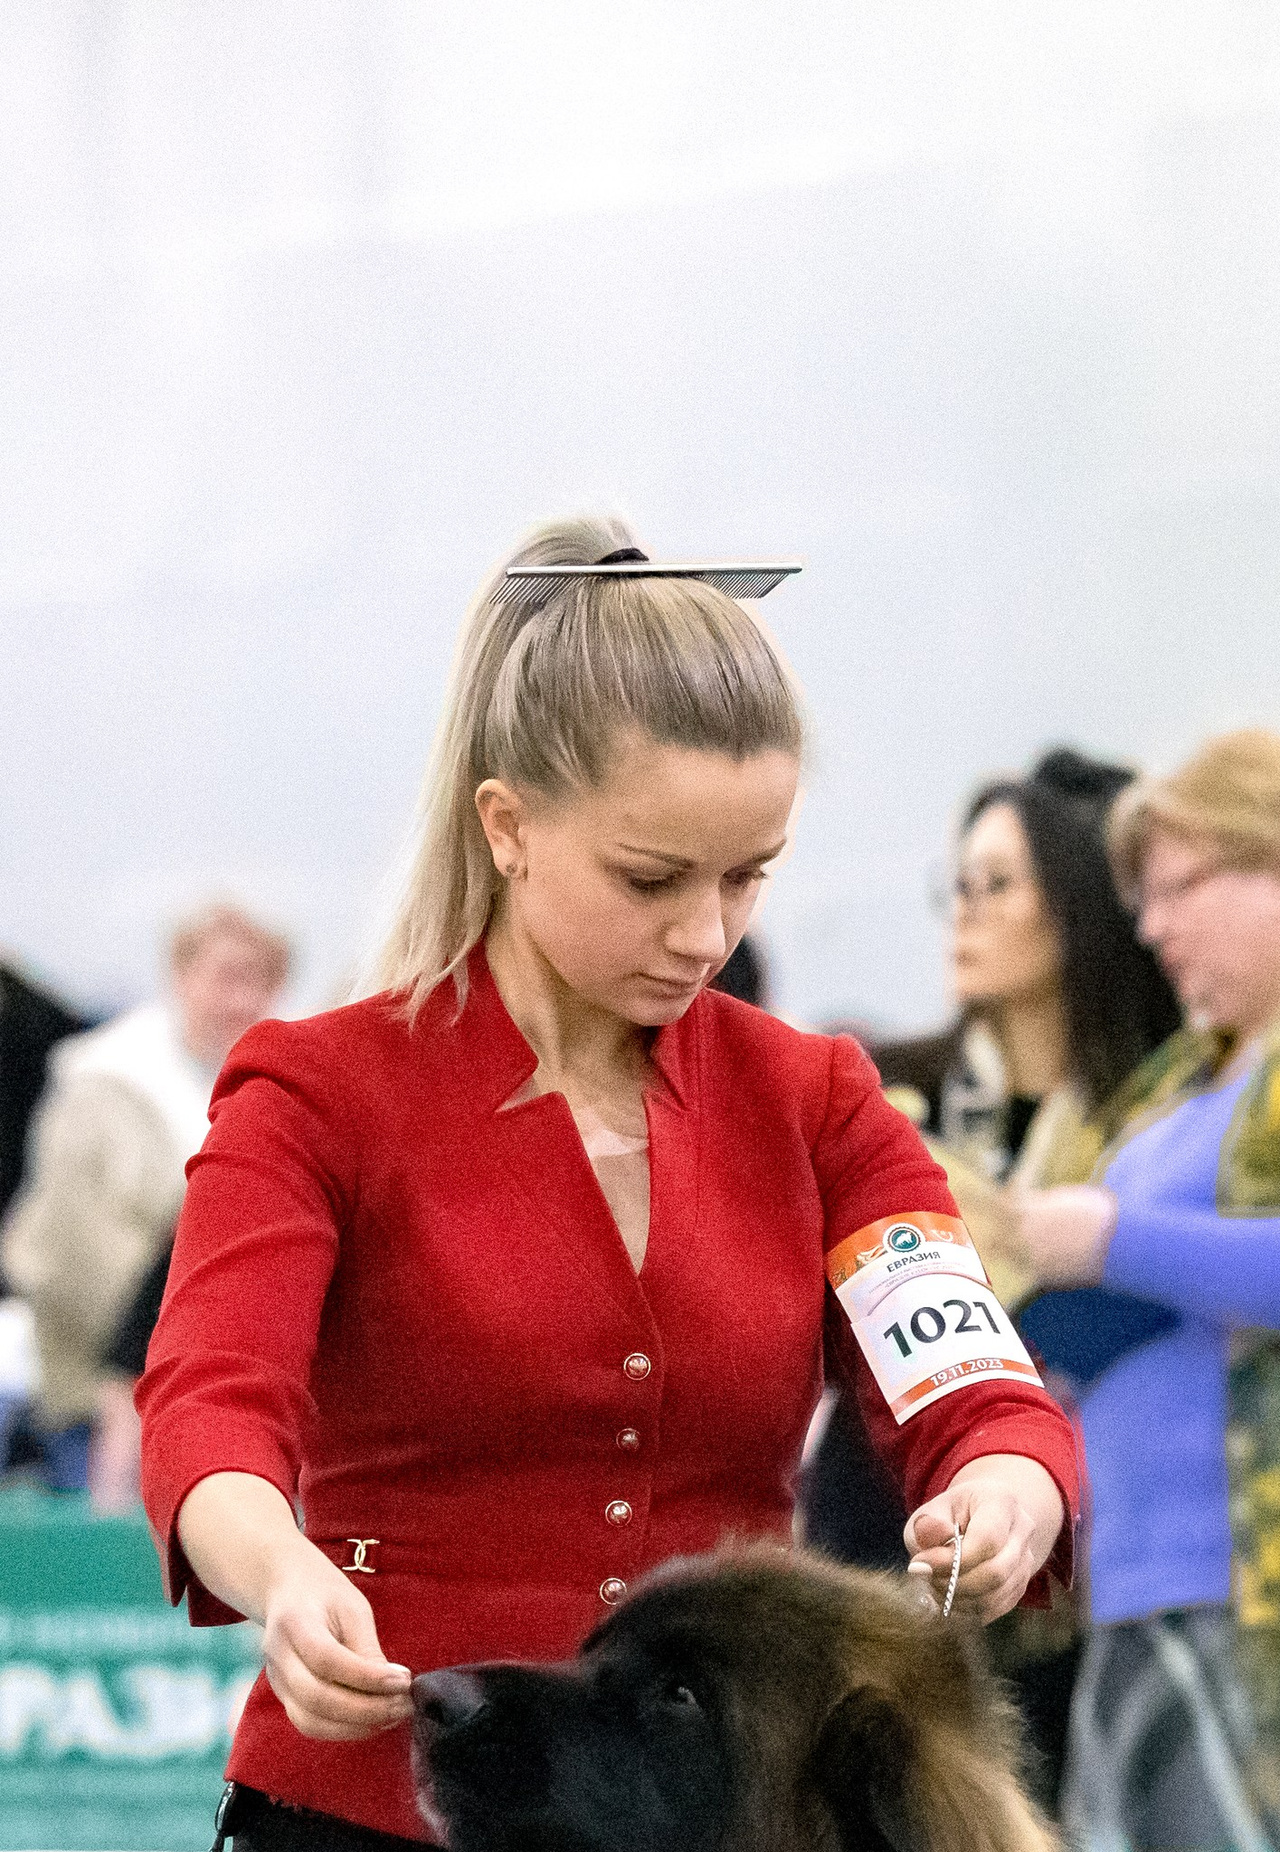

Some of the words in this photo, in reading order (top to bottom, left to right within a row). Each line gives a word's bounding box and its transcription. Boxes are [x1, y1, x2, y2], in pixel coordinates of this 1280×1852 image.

[886, 1251, 941, 1273] ЕВРАЗИЯ
[883, 1299, 1001, 1358] 1021
[931, 1357, 1004, 1386] 19.11.2023
